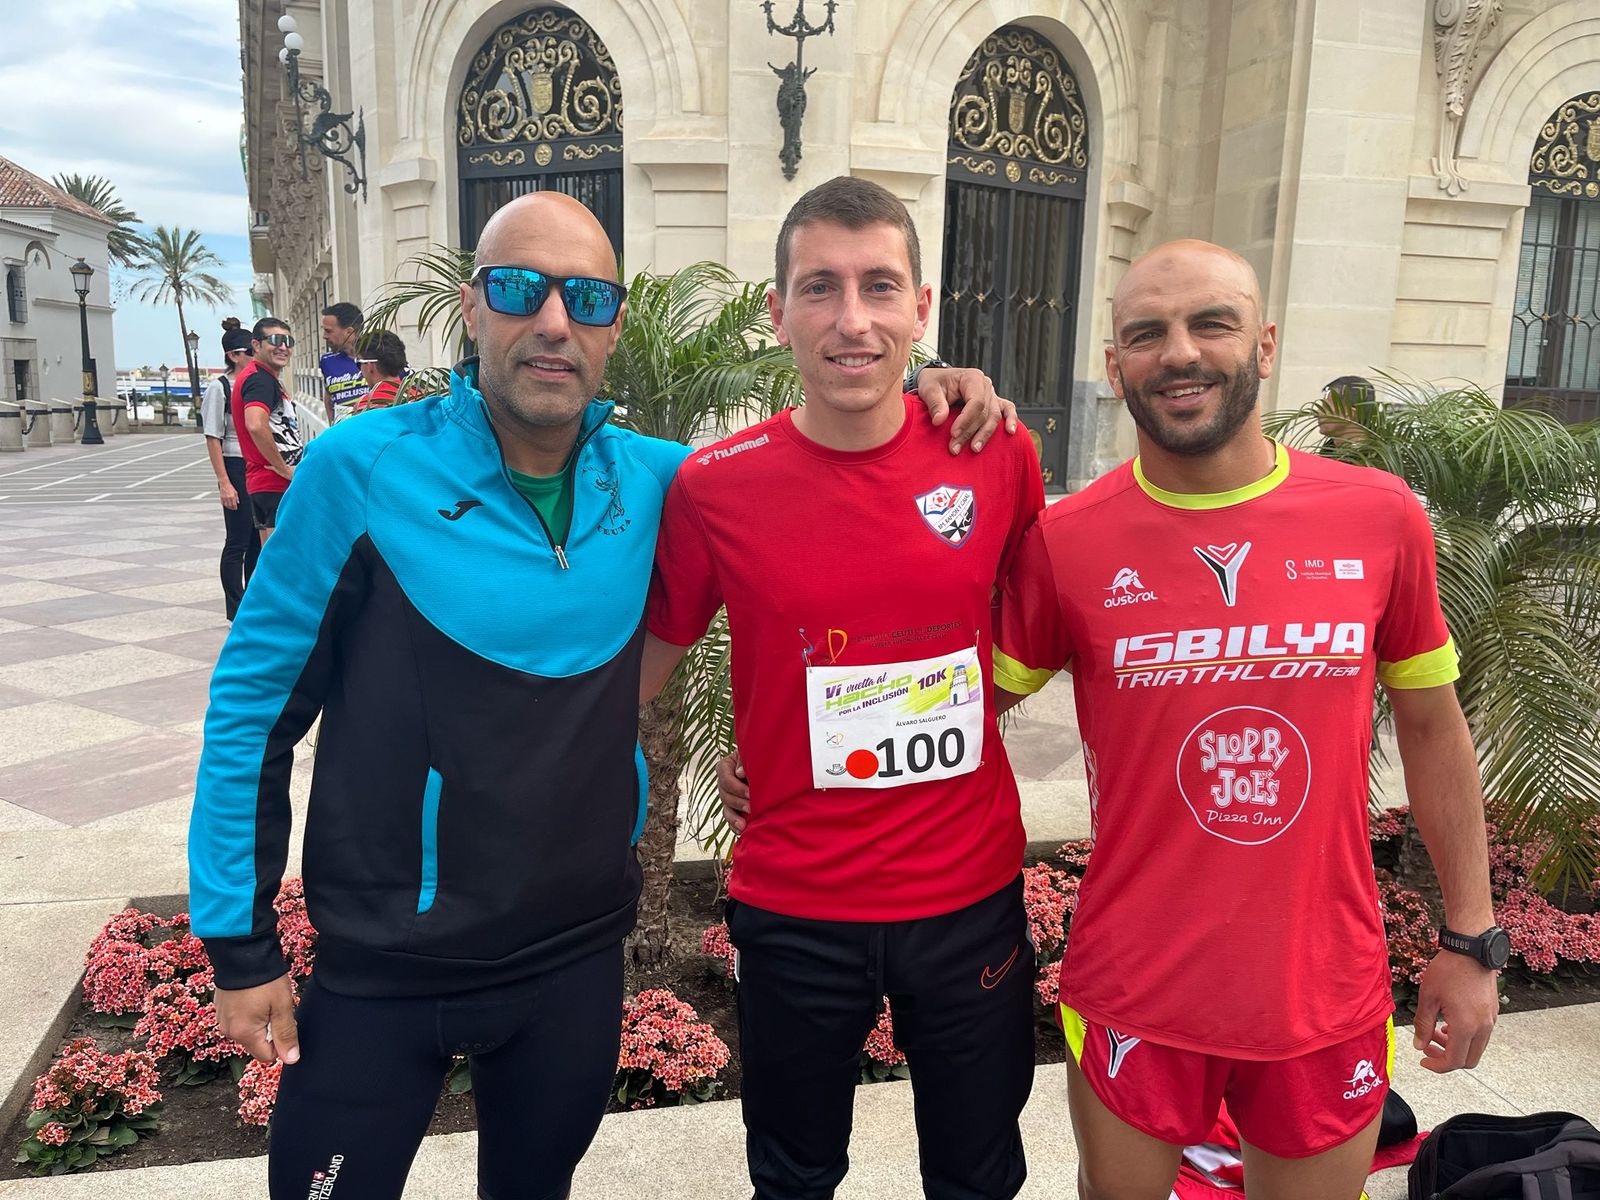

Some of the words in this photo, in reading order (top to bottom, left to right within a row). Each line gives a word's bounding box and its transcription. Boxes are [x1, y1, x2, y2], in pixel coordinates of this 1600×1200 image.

[336, 387, 370, 400] INCLUSI
[713, 433, 770, 460] hummel
[1304, 559, 1325, 568] IMD
[1113, 622, 1366, 668] ISBILYA
[876, 671, 888, 685] al
[917, 667, 947, 690] 10K
[1115, 661, 1329, 689] TRIATHLON
[1326, 666, 1360, 677] TEAM
[838, 708, 852, 716] POR
[862, 686, 909, 709] INCLUSIÓN
[895, 718, 918, 727] ÁLVARO
[918, 714, 947, 724] SALGUERO
[876, 727, 965, 778] 100
[1211, 768, 1281, 808] JOE'S
[1206, 809, 1249, 823] Pizza
[1252, 812, 1283, 825] Inn
